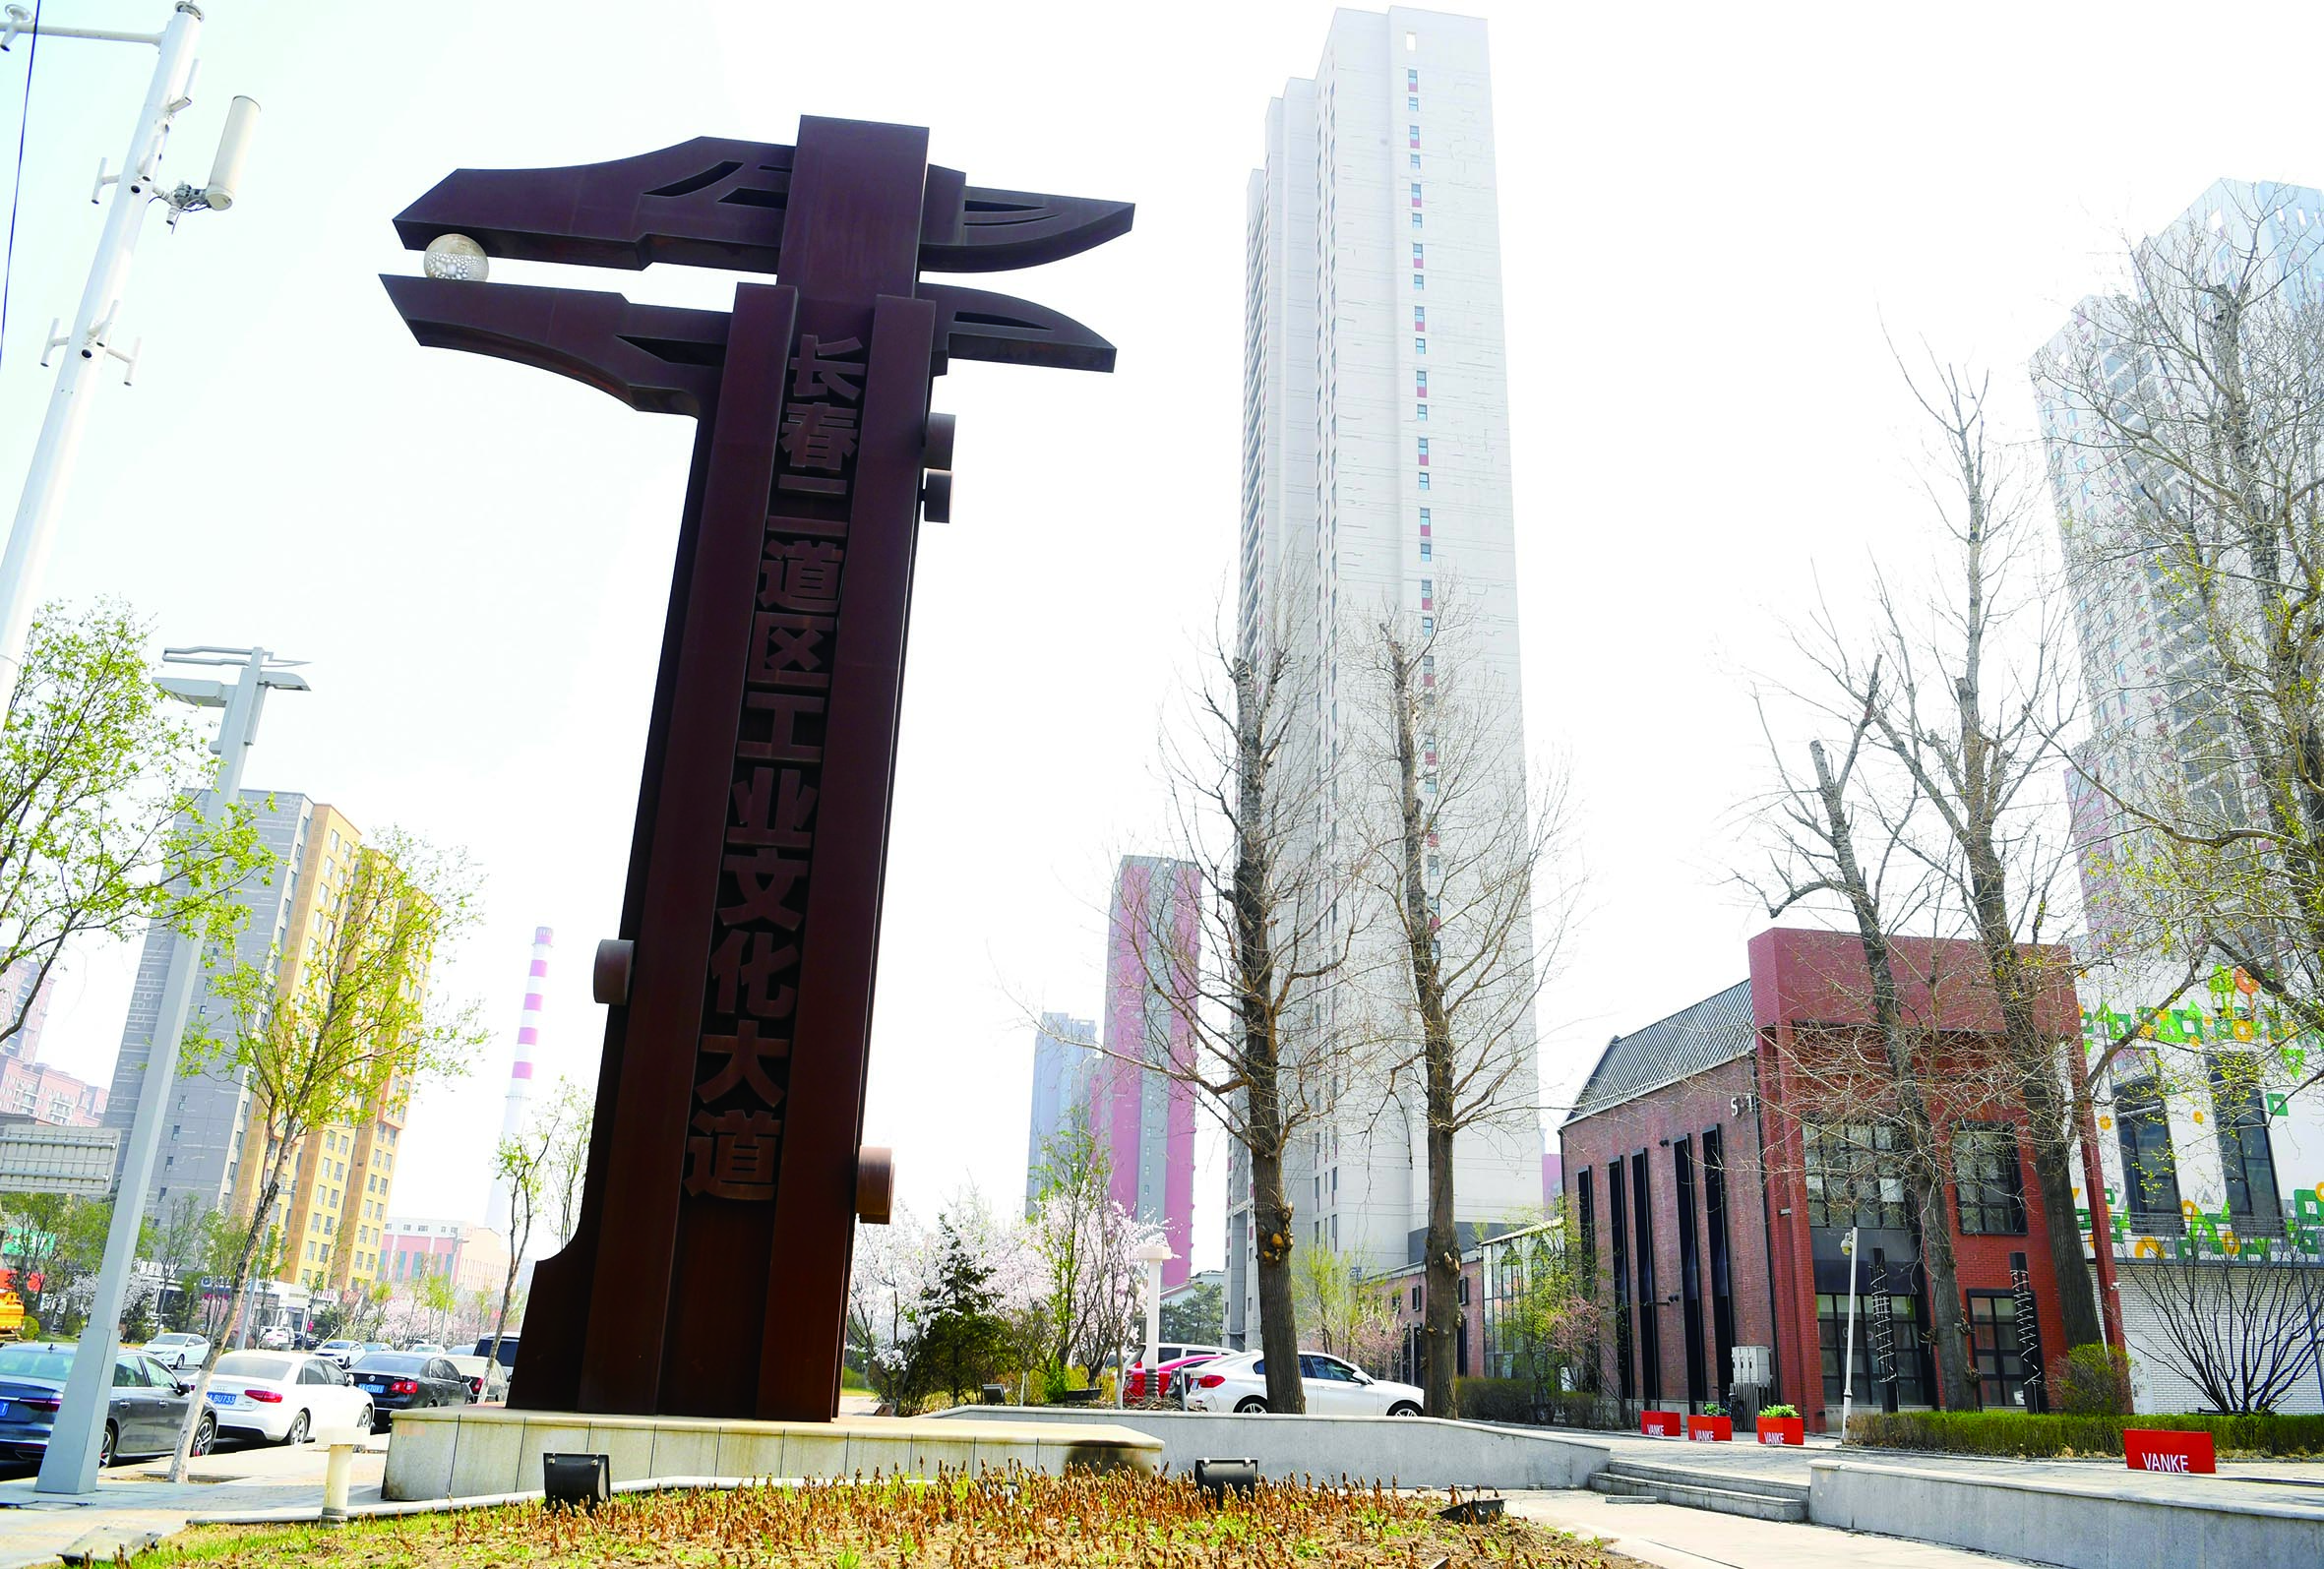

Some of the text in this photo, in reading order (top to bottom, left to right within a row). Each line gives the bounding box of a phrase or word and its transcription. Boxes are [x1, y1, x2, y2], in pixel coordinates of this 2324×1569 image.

[684, 334, 866, 1202] 长春二道区工业文化大道
[1646, 1424, 1665, 1436] VANKE
[1694, 1429, 1714, 1442] VANKE
[1763, 1431, 1785, 1445] VANKE
[2141, 1452, 2190, 1474] VANKE
